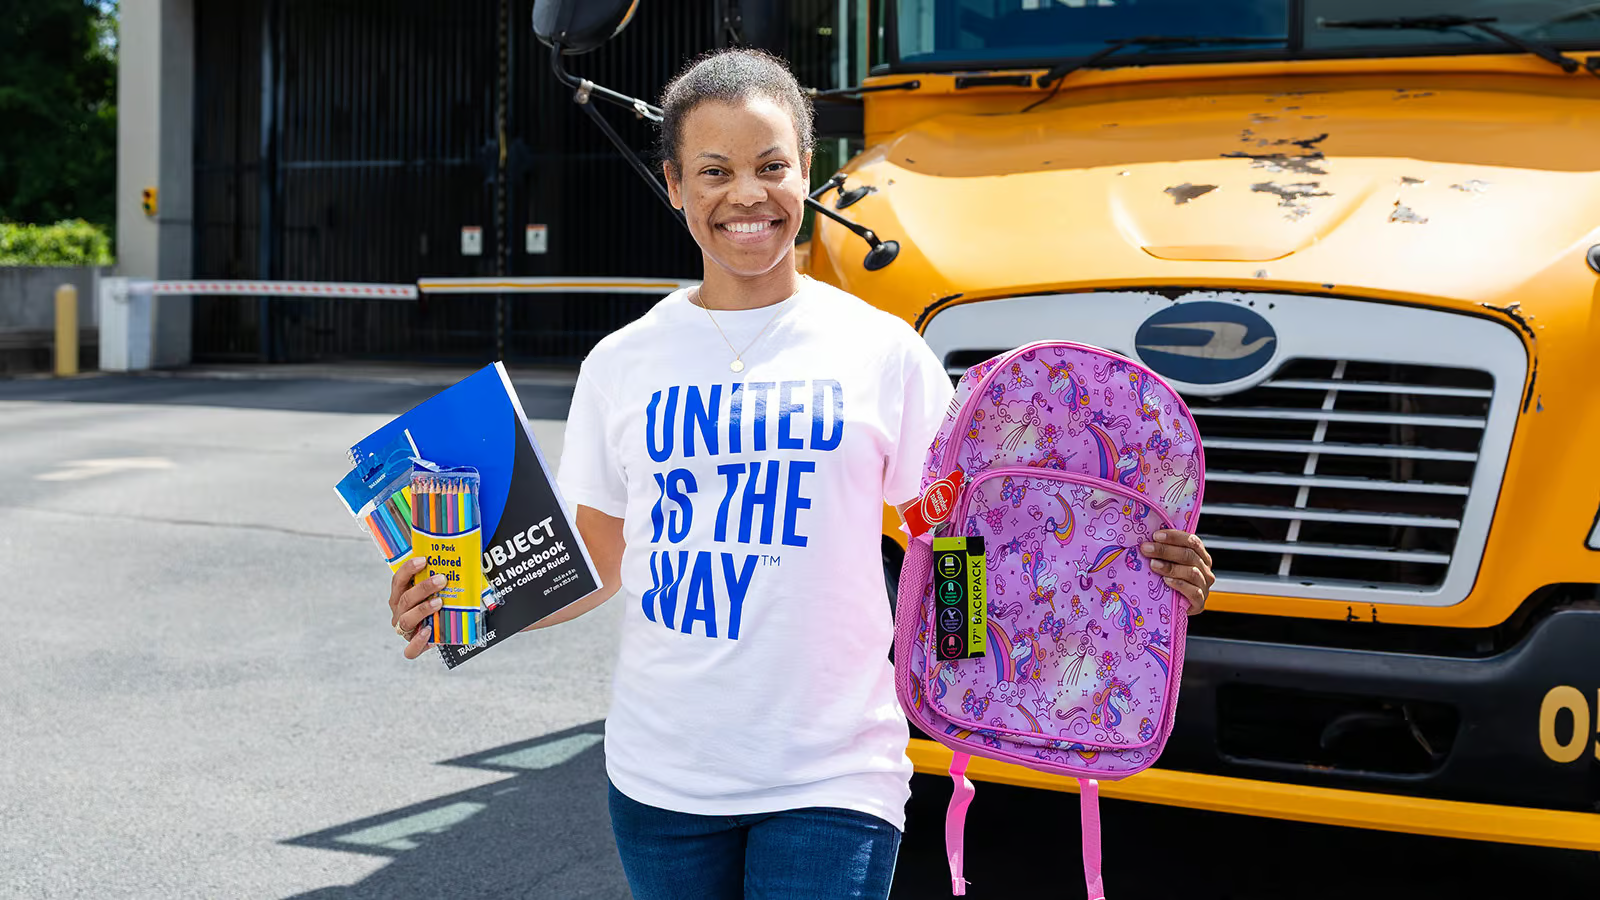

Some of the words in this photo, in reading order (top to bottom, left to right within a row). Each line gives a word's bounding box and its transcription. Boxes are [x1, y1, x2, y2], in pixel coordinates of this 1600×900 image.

[646, 379, 844, 462] UNITED
[651, 468, 698, 543] IS
[714, 460, 815, 547] THE
[930, 493, 942, 517] nation
[935, 487, 948, 512] wonder
[427, 555, 461, 567] Colored
[431, 543, 439, 552] 10
[441, 543, 456, 552] Pack
[481, 516, 555, 574] UBJECT
[489, 573, 507, 587] ral
[505, 541, 567, 580] Notebook
[430, 570, 460, 581] Pcils
[495, 584, 513, 600] eets
[516, 566, 547, 587] College
[546, 552, 571, 571] Ruled
[972, 560, 983, 625] BACKPACK
[1539, 685, 1600, 763] 0
